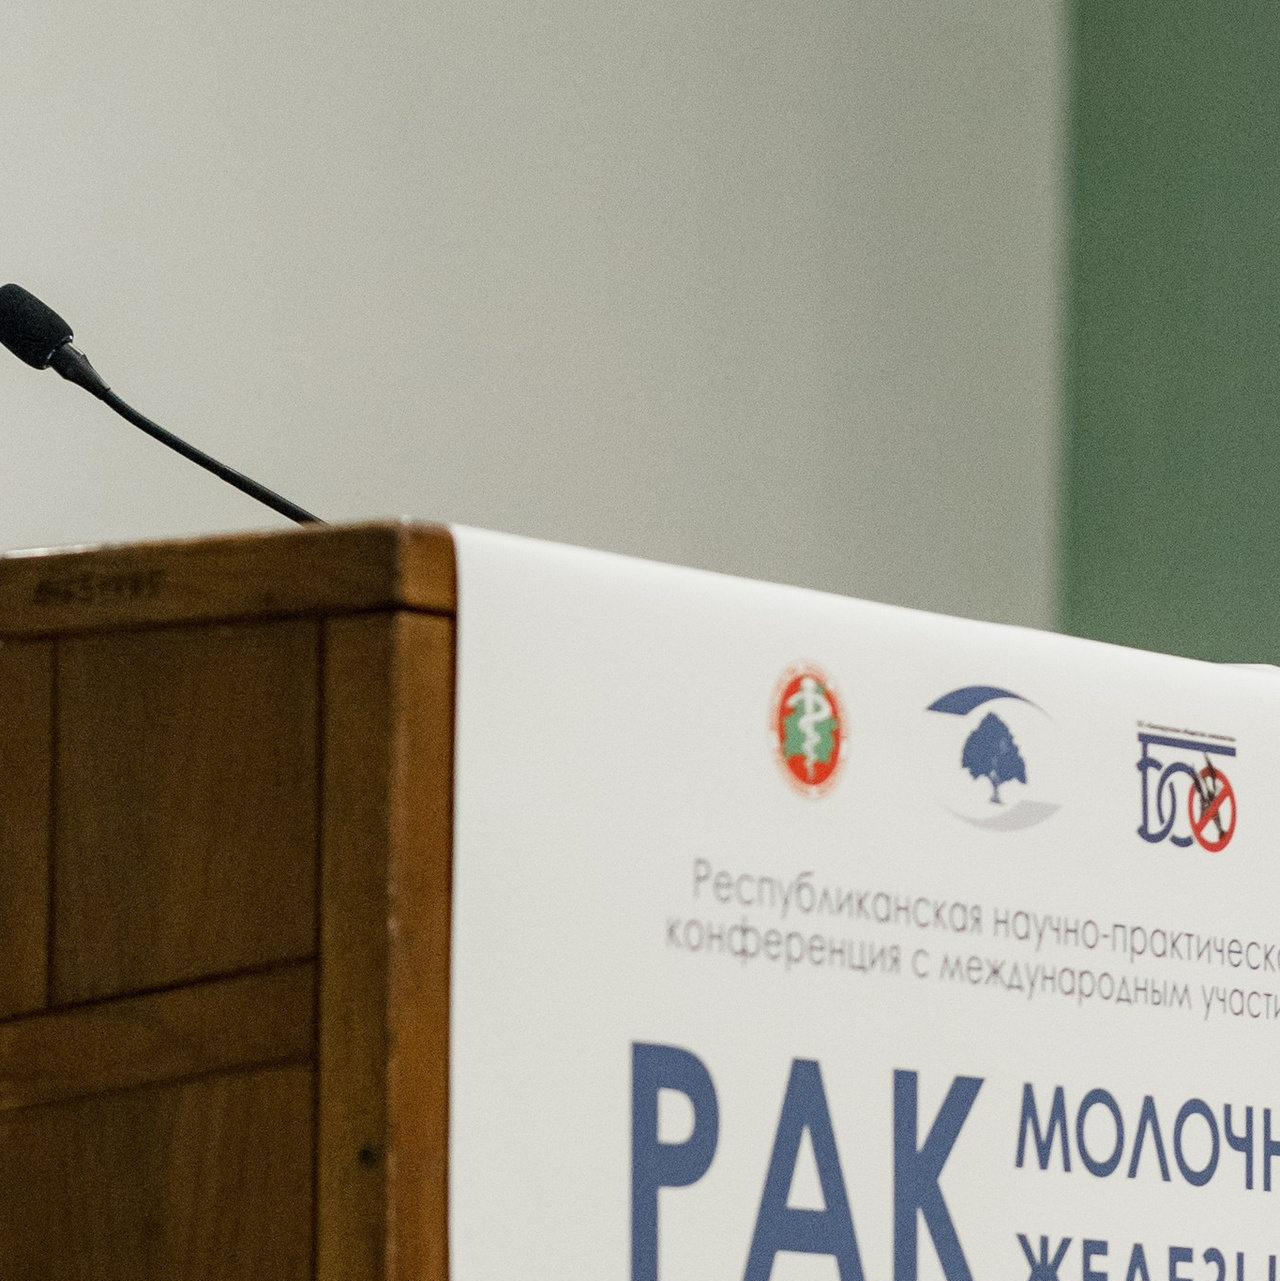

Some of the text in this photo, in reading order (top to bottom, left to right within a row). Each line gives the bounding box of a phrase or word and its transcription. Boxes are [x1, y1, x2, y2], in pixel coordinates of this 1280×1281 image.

[666, 915, 901, 975] конференция
[912, 949, 930, 979] с
[939, 954, 1192, 1010] международным
[692, 857, 1280, 973] Республиканская научно-практическ
